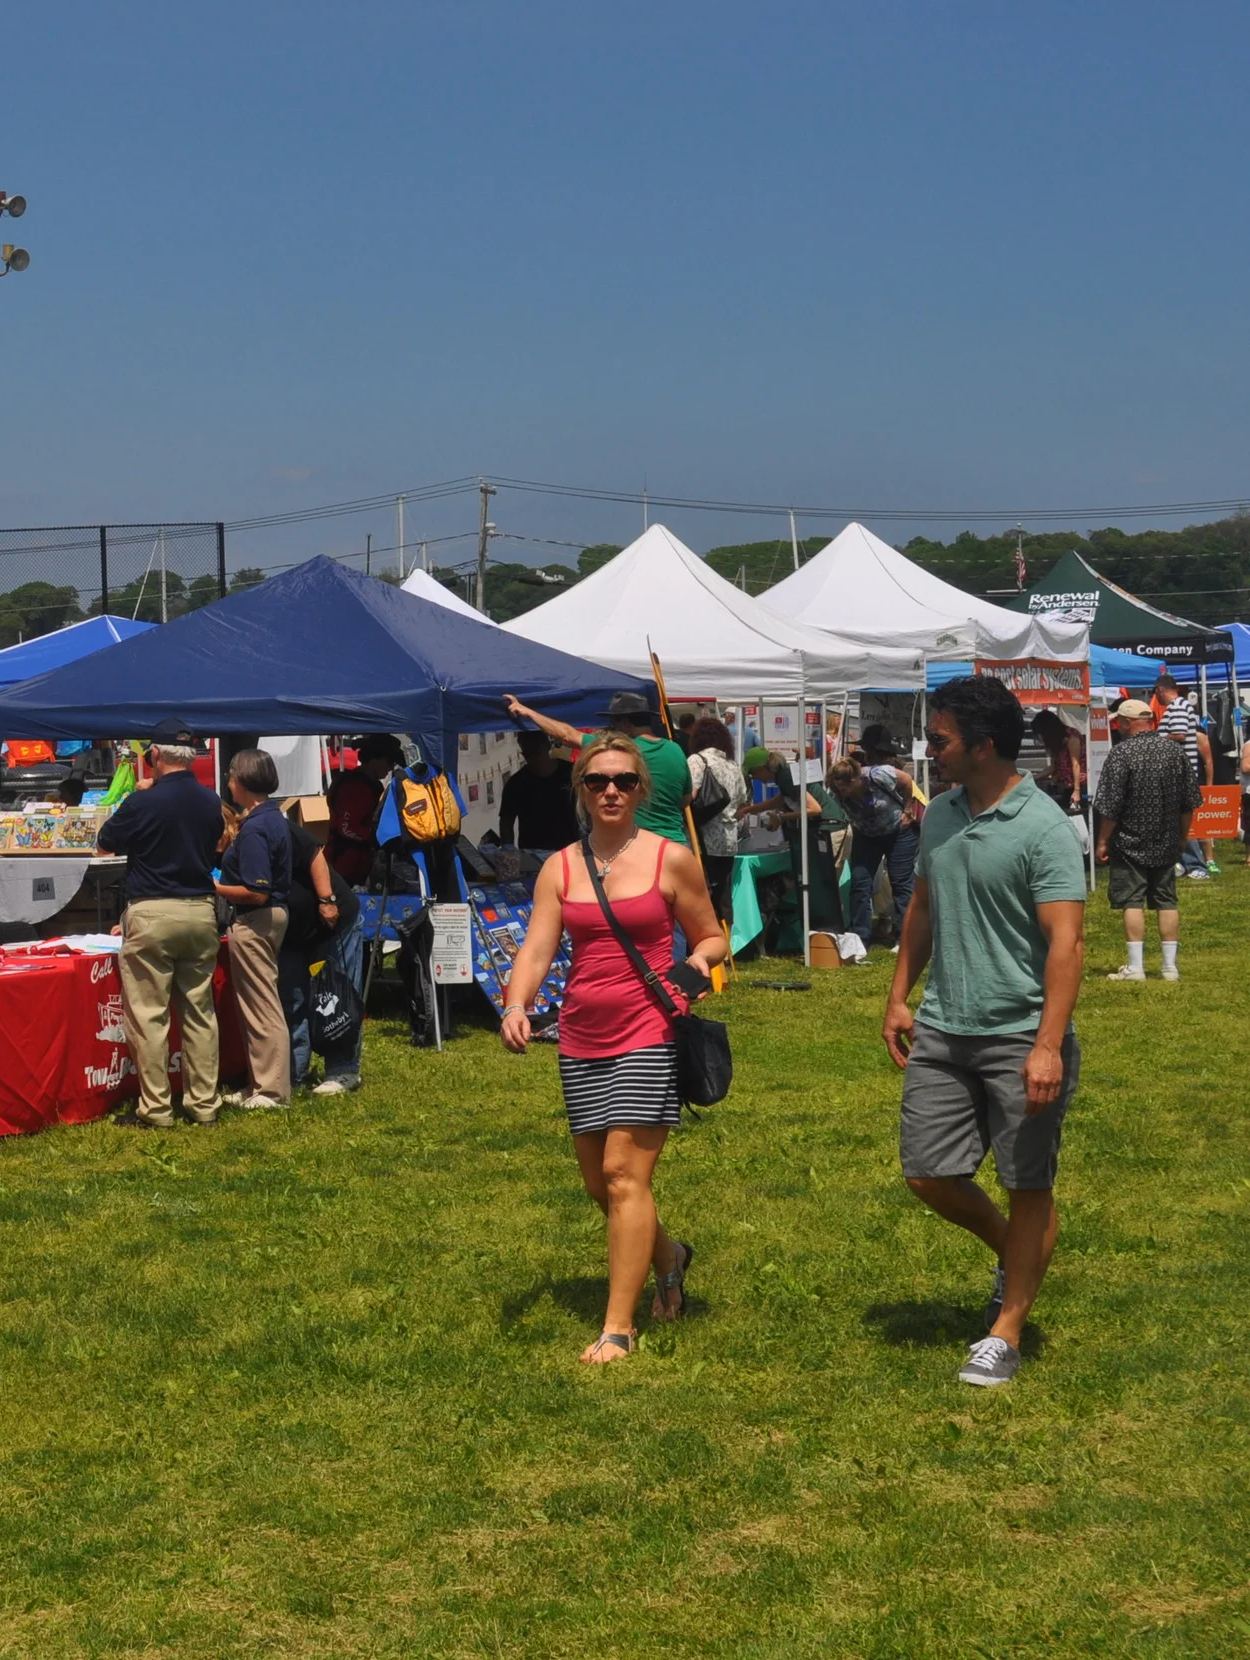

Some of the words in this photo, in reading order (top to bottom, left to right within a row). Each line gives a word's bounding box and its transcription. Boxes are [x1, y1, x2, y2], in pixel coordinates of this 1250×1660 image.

[1029, 590, 1100, 604] Renewal
[1136, 644, 1193, 656] Company
[1015, 663, 1041, 690] solar
[1208, 794, 1228, 805] less
[1197, 811, 1232, 822] power.
[36, 882, 50, 893] 404
[90, 956, 113, 984] Call
[84, 1065, 109, 1089] Tow
